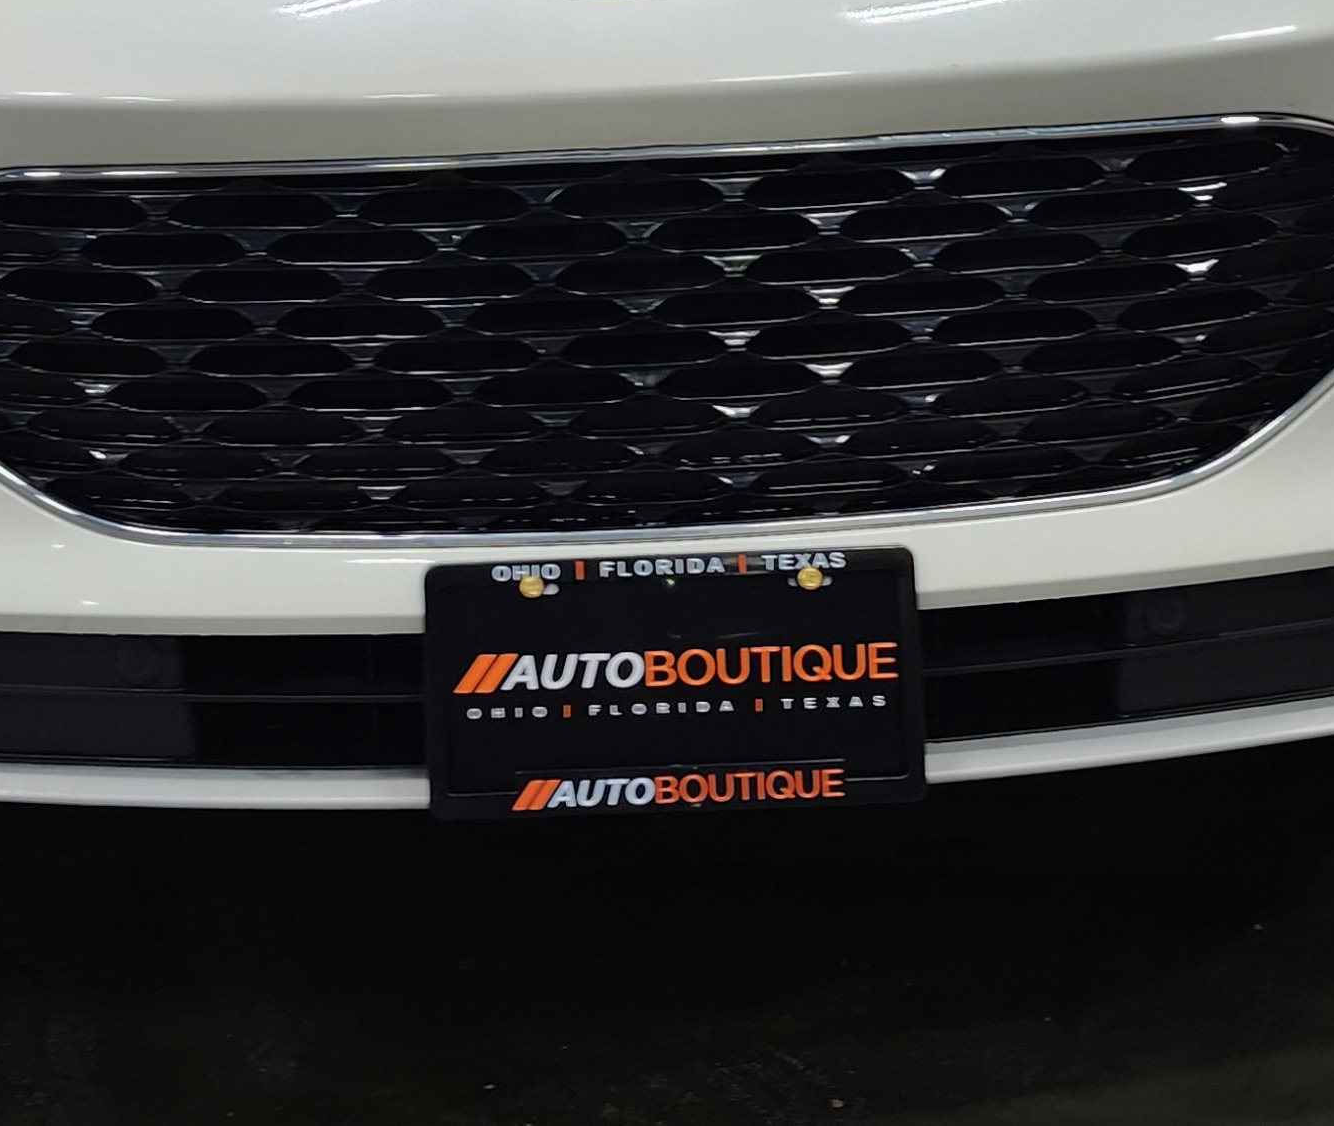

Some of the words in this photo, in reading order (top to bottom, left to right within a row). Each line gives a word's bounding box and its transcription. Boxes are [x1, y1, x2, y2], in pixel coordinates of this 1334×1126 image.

[491, 563, 561, 582] OHIO
[598, 557, 726, 578] FLORIDA
[762, 551, 847, 571] TEXAS
[500, 641, 899, 691] AUTOBOUTIQUE
[466, 705, 548, 720] OHIO
[587, 700, 735, 716] FLORIDA
[780, 694, 887, 710] TEXAS
[547, 768, 846, 809] AUTOBOUTIQUE
